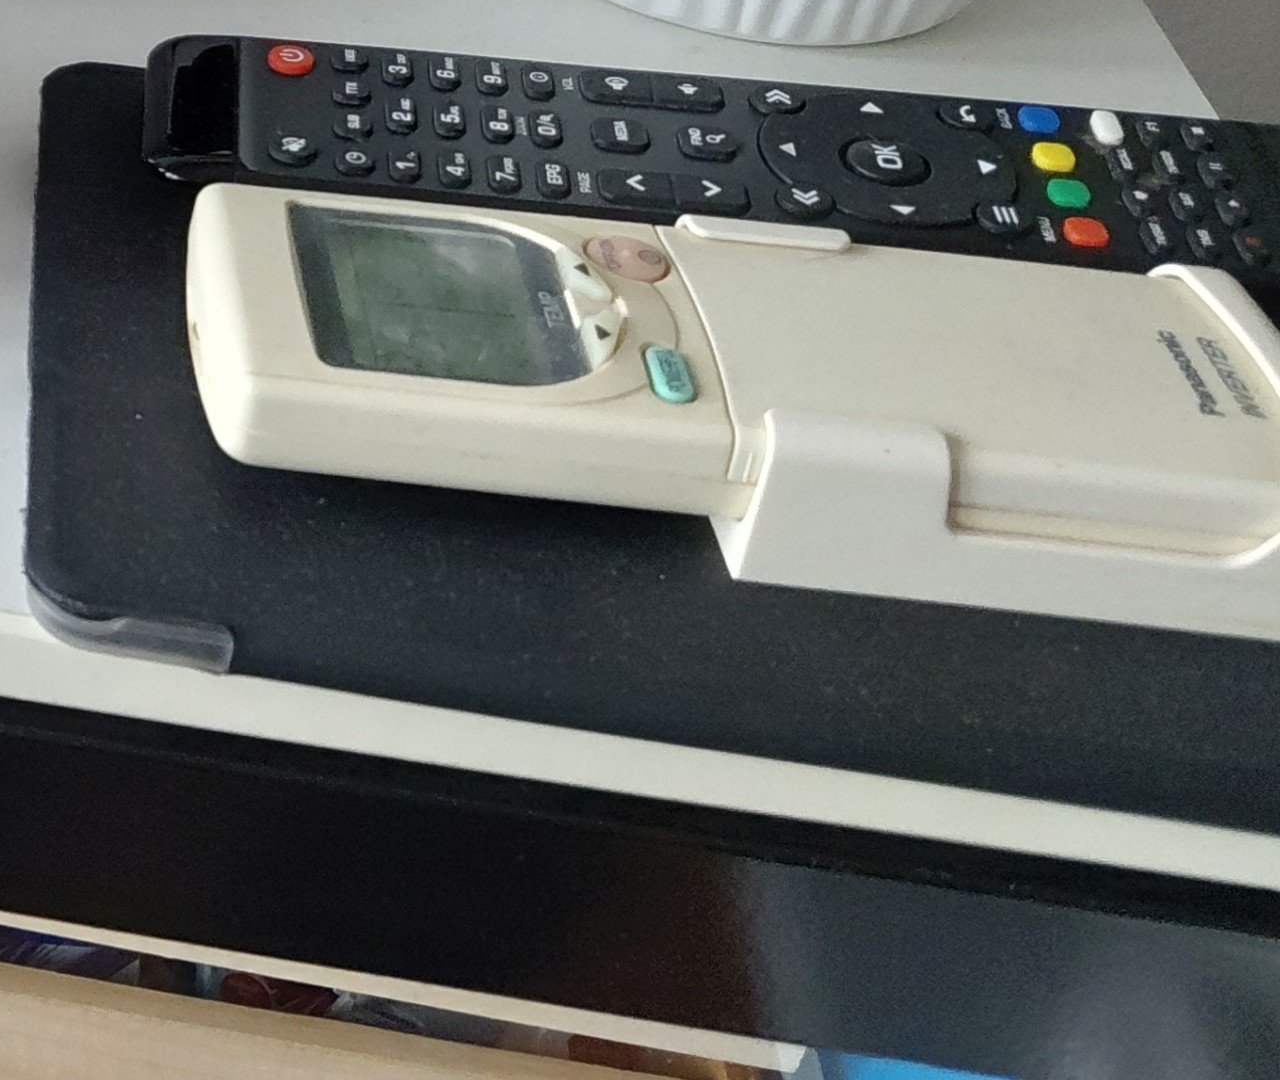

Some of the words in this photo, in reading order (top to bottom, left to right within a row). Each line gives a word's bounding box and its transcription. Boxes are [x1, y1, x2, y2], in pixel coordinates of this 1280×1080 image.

[388, 64, 407, 74] 3
[436, 69, 455, 79] 6
[483, 75, 503, 85] 9
[561, 76, 574, 91] VOL
[347, 114, 361, 130] SUB
[392, 111, 412, 122] 2
[440, 113, 460, 124] 5
[489, 121, 509, 132] 8
[688, 127, 703, 146] FIND
[871, 143, 903, 170] OK
[395, 161, 417, 169] 1
[445, 165, 465, 176] 4
[495, 171, 516, 182] 7
[545, 163, 564, 186] EPG
[577, 171, 591, 194] PAGE
[1156, 329, 1226, 418] Panasonic
